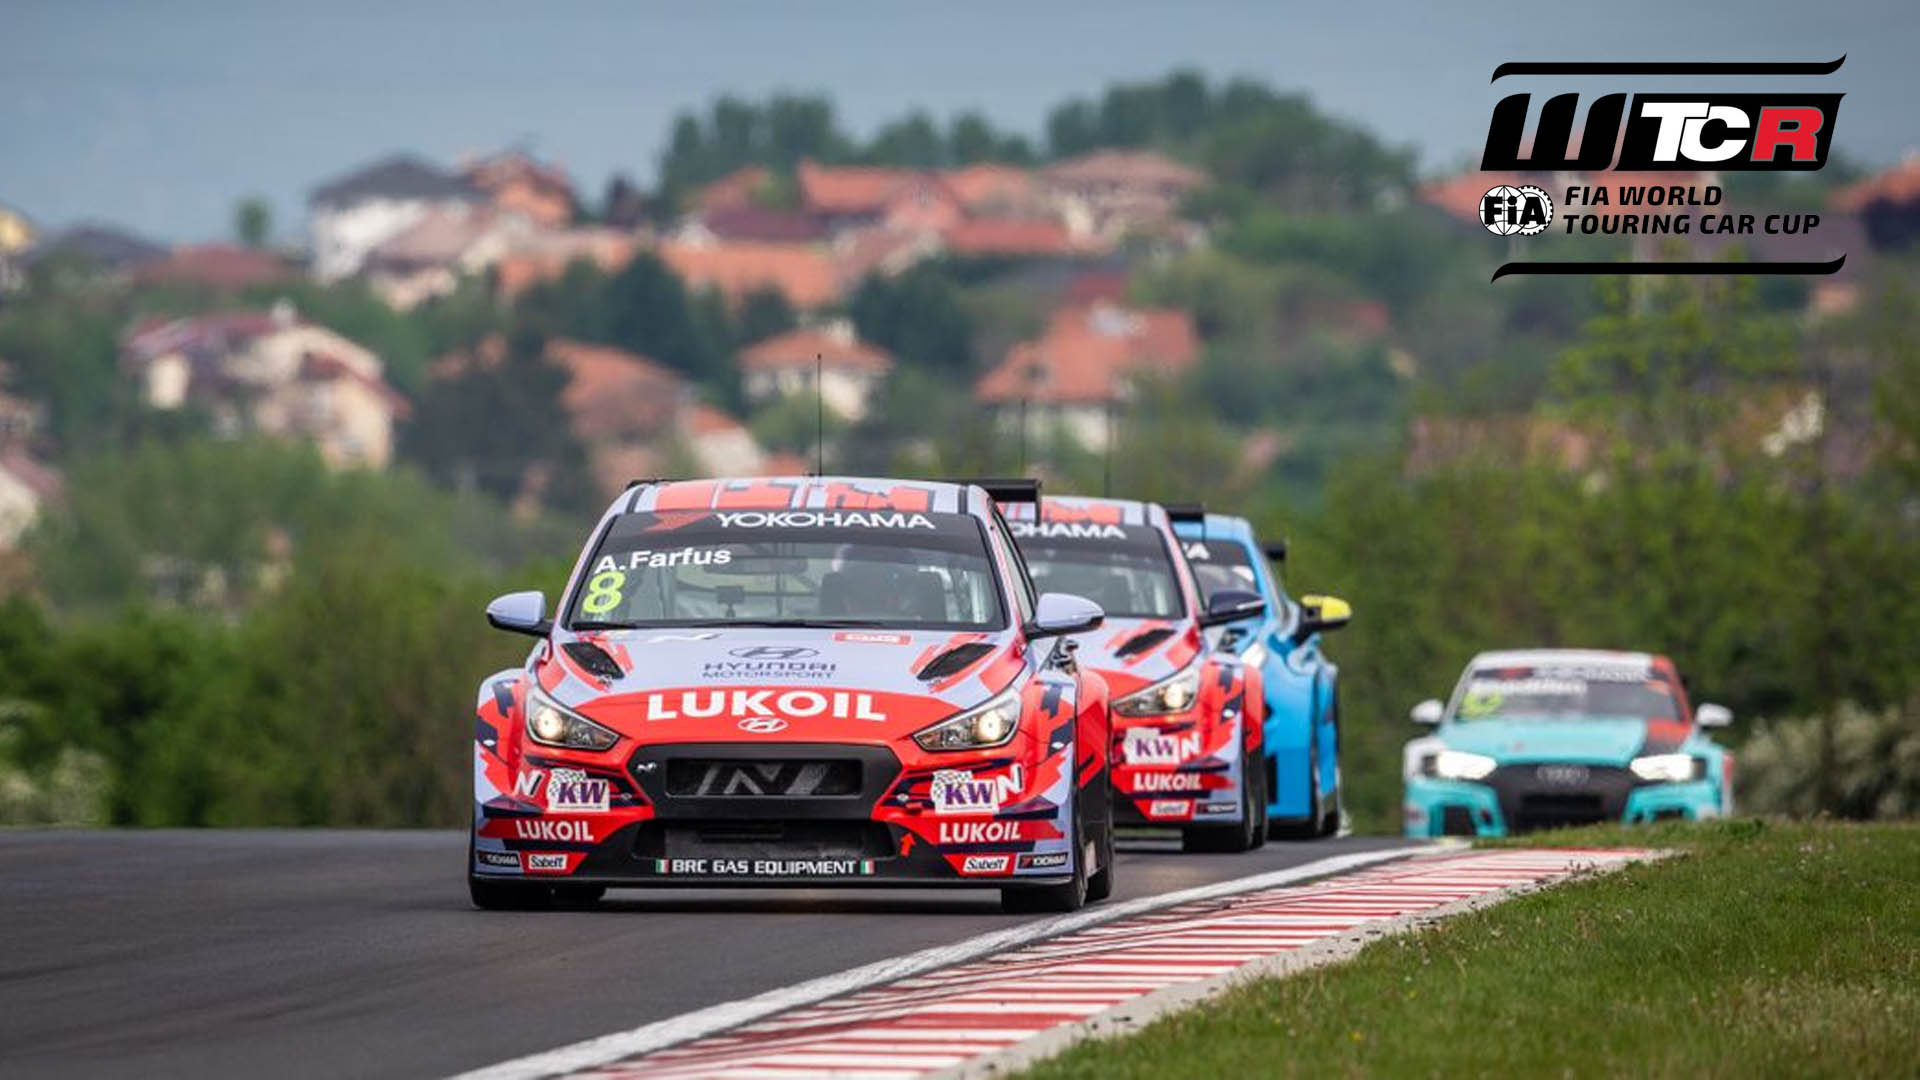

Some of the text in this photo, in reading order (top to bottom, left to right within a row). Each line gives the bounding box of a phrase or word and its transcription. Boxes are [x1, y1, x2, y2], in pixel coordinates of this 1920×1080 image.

[715, 511, 936, 530] YOKOHAMA
[1009, 522, 1128, 540] OHAMA
[582, 571, 626, 614] 8
[701, 671, 836, 680] MOTORSPORT
[703, 662, 836, 672] HYUNDAI
[647, 690, 887, 723] LUKOIL
[1135, 738, 1174, 757] KW
[1132, 771, 1204, 792] LUKOIL
[557, 781, 608, 805] KW
[944, 782, 994, 806] KW
[515, 819, 595, 842] LUKOIL
[939, 821, 1022, 843] LUKOIL
[672, 859, 856, 875] BRC GAS EQUIPMENT
